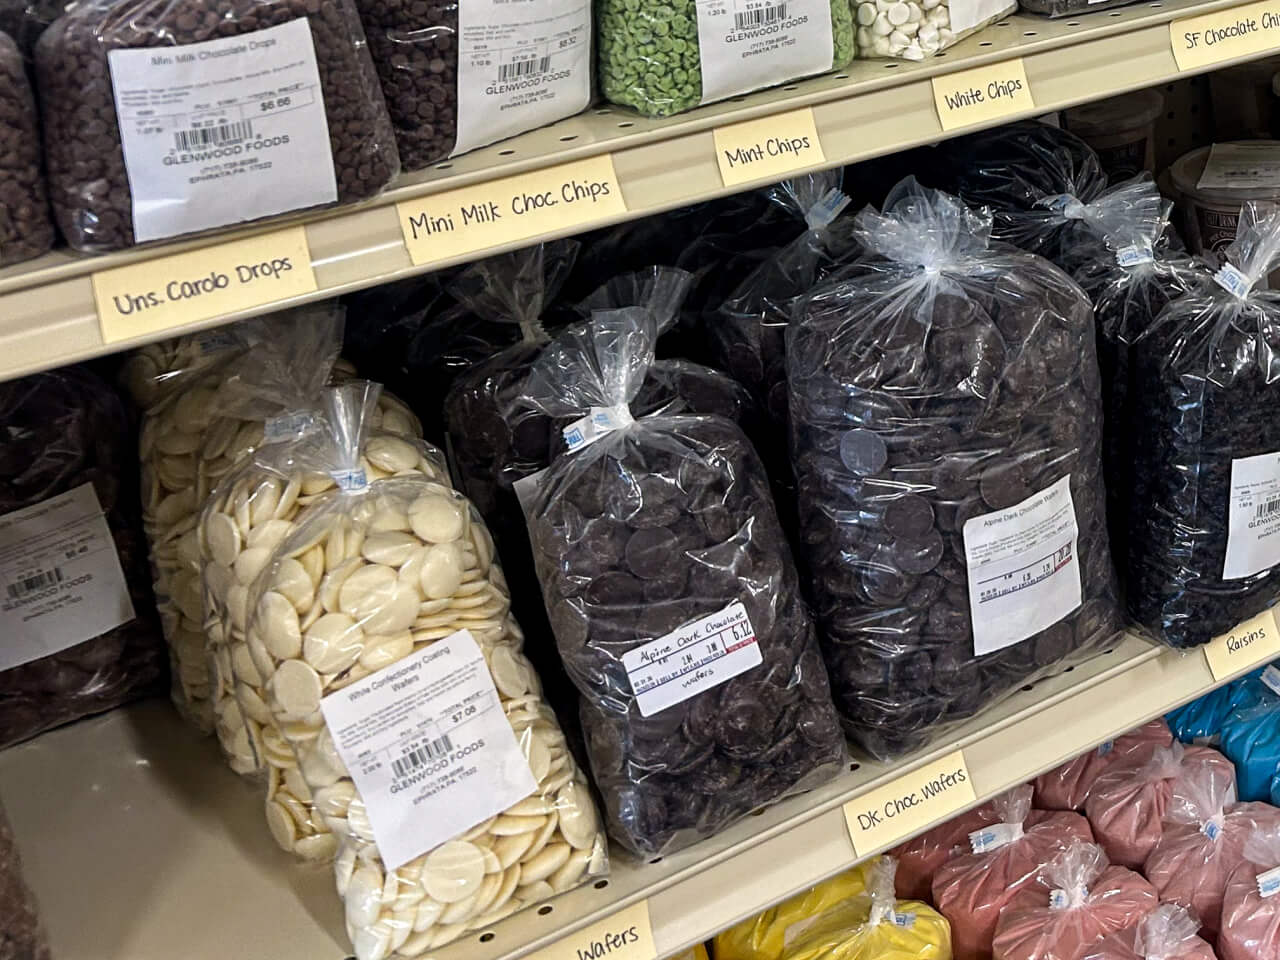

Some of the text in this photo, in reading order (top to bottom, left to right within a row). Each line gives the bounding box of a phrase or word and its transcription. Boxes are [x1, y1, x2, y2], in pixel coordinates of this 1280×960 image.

[725, 15, 809, 43] GLENWOOD FOODS
[1184, 29, 1202, 49] SF
[1203, 17, 1258, 46] Chocolate
[486, 69, 572, 95] GLENWOOD FOODS
[943, 76, 1023, 113] White Chips
[162, 134, 290, 167] GLENWOOD FOODS
[724, 133, 812, 169] Mint Chips
[409, 211, 455, 240] Mini
[461, 199, 502, 228] Milk
[561, 177, 611, 205] Chips
[113, 255, 293, 318] Uns. Carob Drops
[983, 515, 1003, 528] Alpine
[1003, 510, 1019, 522] Dark
[640, 644, 673, 665] Alpine
[677, 630, 702, 647] Dark
[732, 620, 752, 641] 6.12
[1226, 625, 1267, 656] Raisins
[348, 644, 451, 702] White Confectionery Coating
[391, 672, 421, 693] Wafers
[389, 738, 487, 795] GLENWOOD FOODS
[857, 765, 968, 833] DK. Choc. Wafers
[575, 922, 640, 959] Wafers
